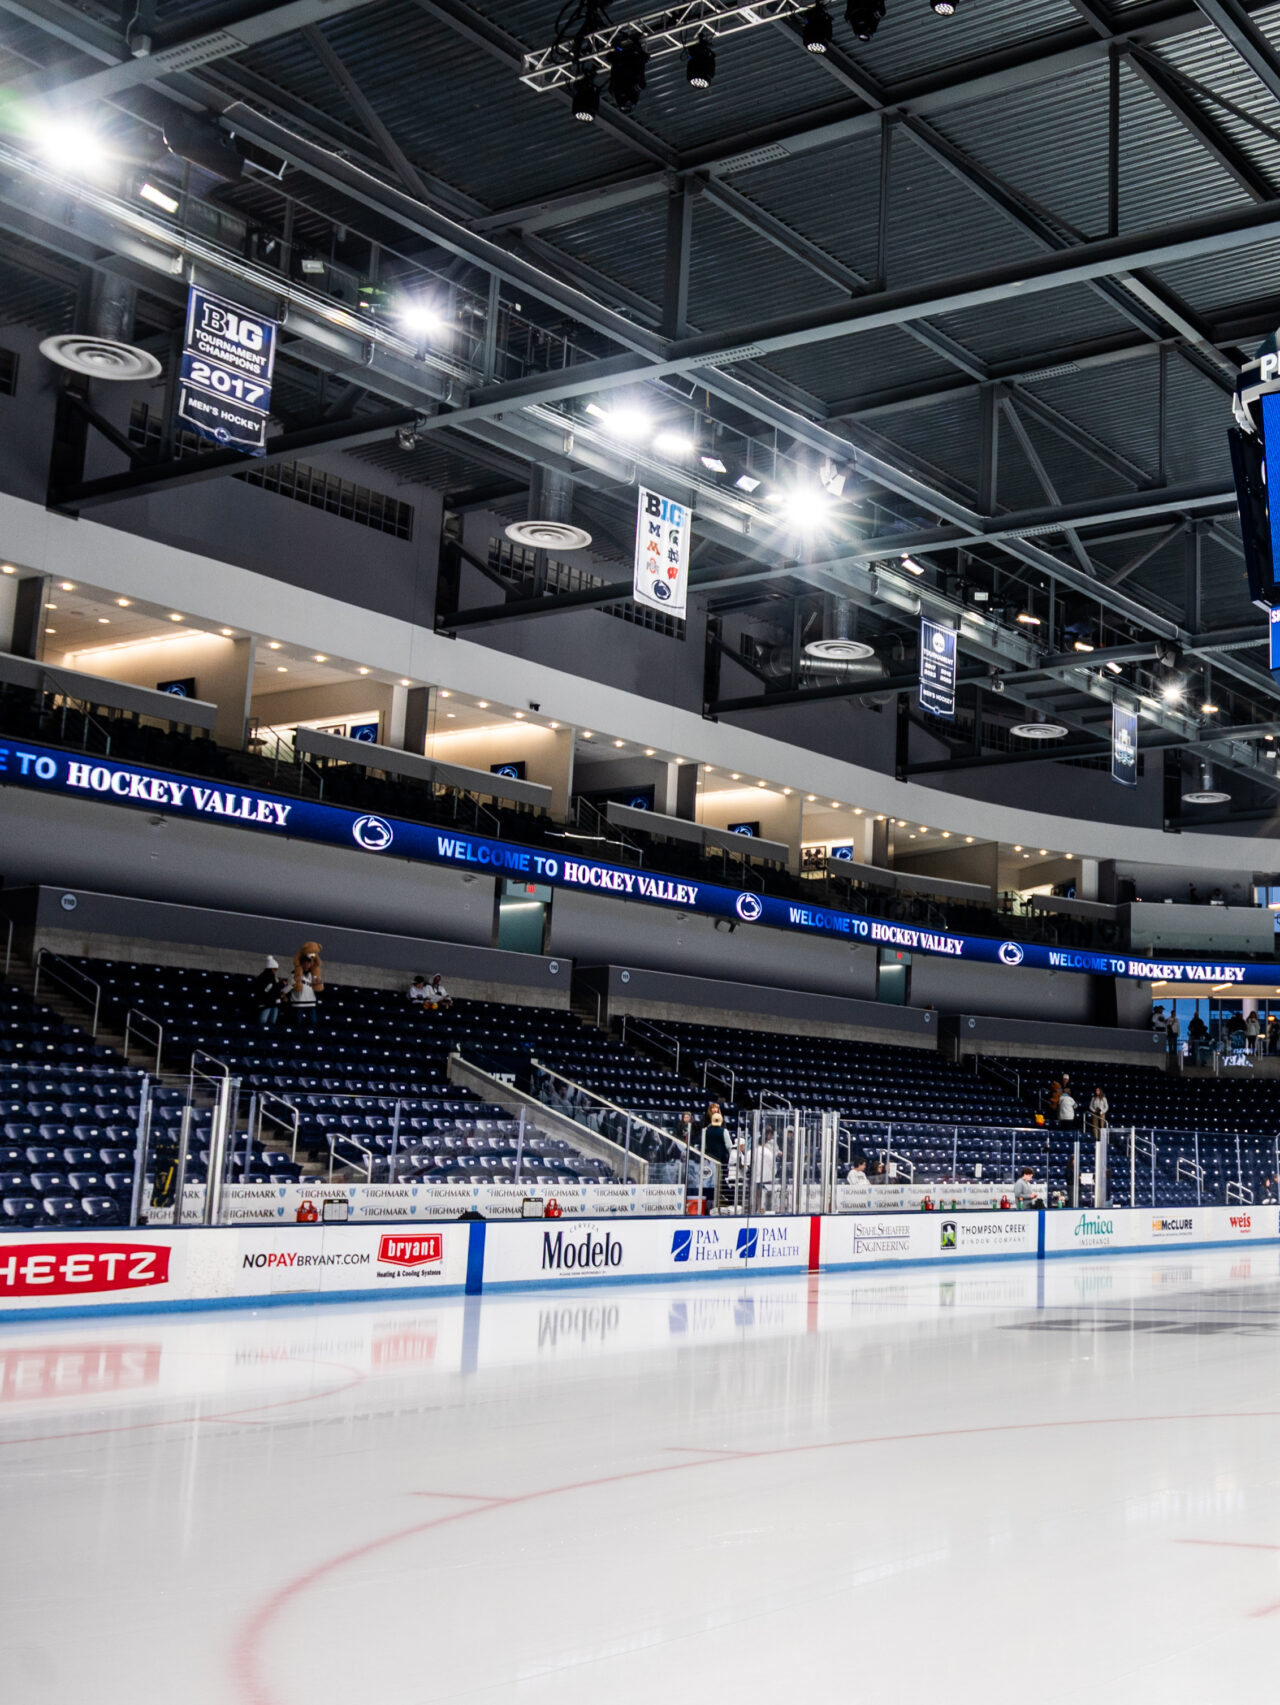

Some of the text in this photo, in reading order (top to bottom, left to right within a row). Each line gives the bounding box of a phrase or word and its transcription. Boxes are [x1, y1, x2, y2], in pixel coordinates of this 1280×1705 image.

[194, 329, 267, 366] TOURNAMENT
[198, 342, 261, 374] CHAMPIONS
[190, 362, 264, 403] 2017
[188, 398, 260, 431] MEN'S HOCKEY
[16, 752, 57, 779] TO
[66, 761, 190, 806] HOCKEY
[190, 785, 292, 826] VALLEY
[437, 836, 699, 904] WELCOME TO HOCKEY VALLEY
[789, 907, 964, 955] WELCOME TO HOCKEY VALLEY
[1048, 951, 1246, 981] WELCOME TO HOCKEY VALLEY
[300, 1189, 347, 1199] HIGHMARK
[365, 1188, 409, 1198] HIGHMARK
[431, 1188, 471, 1198] HIGHMARK
[490, 1188, 528, 1198] HIGHMARK
[543, 1188, 581, 1197] HIGHMARK
[596, 1188, 630, 1197] HIGHMARK
[645, 1188, 678, 1197] HIGHMARK
[363, 1206, 408, 1216] HIGHMARK
[488, 1205, 523, 1215] HIGHMAR
[644, 1204, 677, 1213] HIGHMARK
[1074, 1213, 1114, 1237] Amica
[1229, 1212, 1251, 1228] weis
[762, 1227, 788, 1241] PAM
[961, 1224, 1026, 1236] THOMPSON CREEK
[388, 1239, 435, 1259] bryant
[542, 1231, 623, 1269] Modelo
[761, 1244, 799, 1258] HEALTH
[242, 1253, 370, 1268] NOPAYBRYANT.COM
[402, 1270, 420, 1278] Cooling
